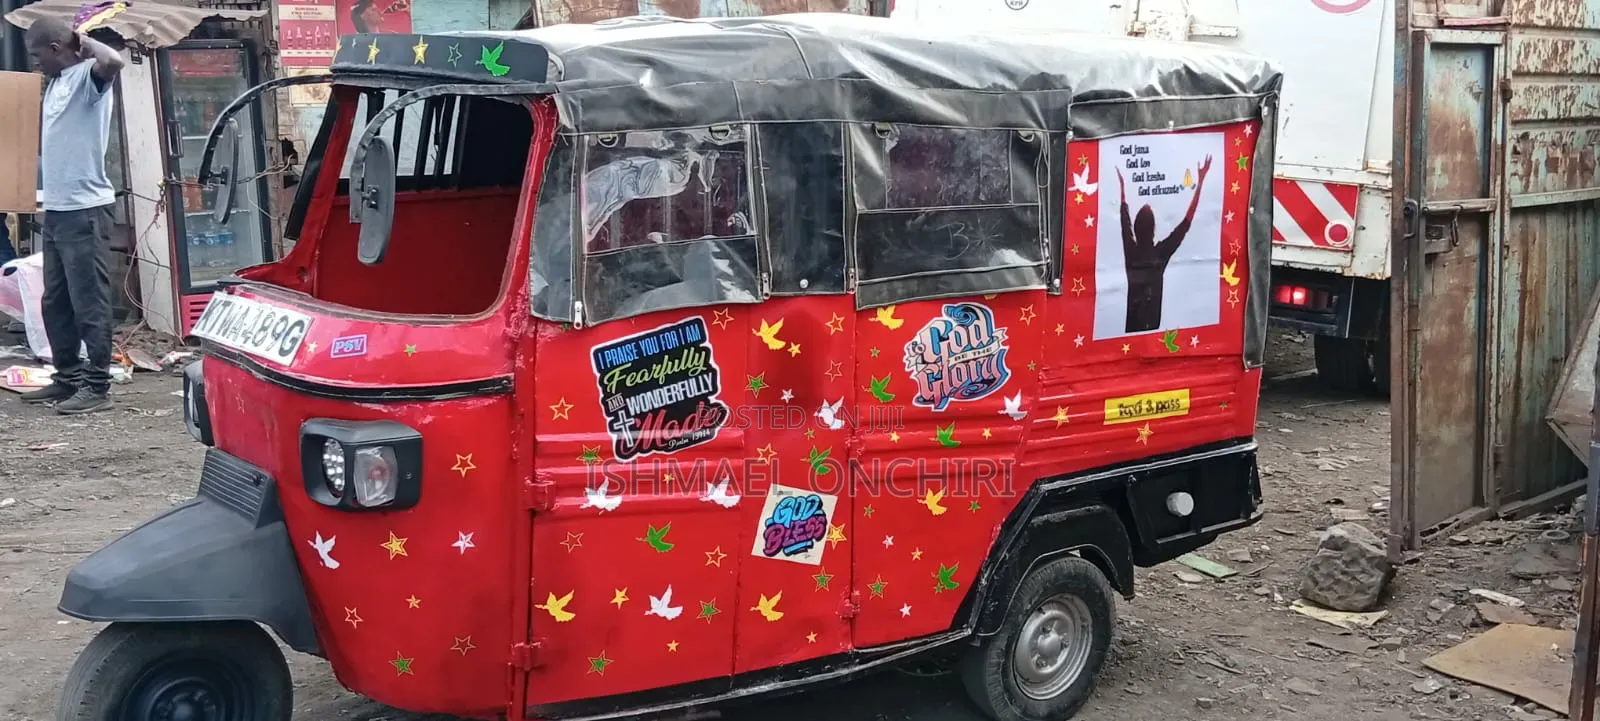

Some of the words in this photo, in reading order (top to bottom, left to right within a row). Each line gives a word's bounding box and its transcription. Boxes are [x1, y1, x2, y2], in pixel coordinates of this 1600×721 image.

[1119, 144, 1132, 155] God
[1126, 158, 1139, 169] God
[1132, 172, 1145, 182] God
[1138, 186, 1150, 196] God
[334, 338, 363, 354] PSV
[598, 352, 605, 370] I
[605, 343, 639, 368] PRAISE
[639, 336, 660, 357] YOU
[660, 330, 679, 351] FOR
[679, 327, 685, 345] I
[686, 323, 701, 342] AM
[920, 305, 993, 363] God
[603, 347, 706, 394] Fearfully
[954, 350, 968, 361] BE
[972, 347, 993, 357] THE
[607, 395, 624, 411] AND
[626, 372, 713, 416] WONDERFULLY
[917, 343, 1006, 409] Glory
[620, 401, 719, 455] Made
[773, 494, 821, 528] GOD
[763, 515, 826, 556] BLESS
